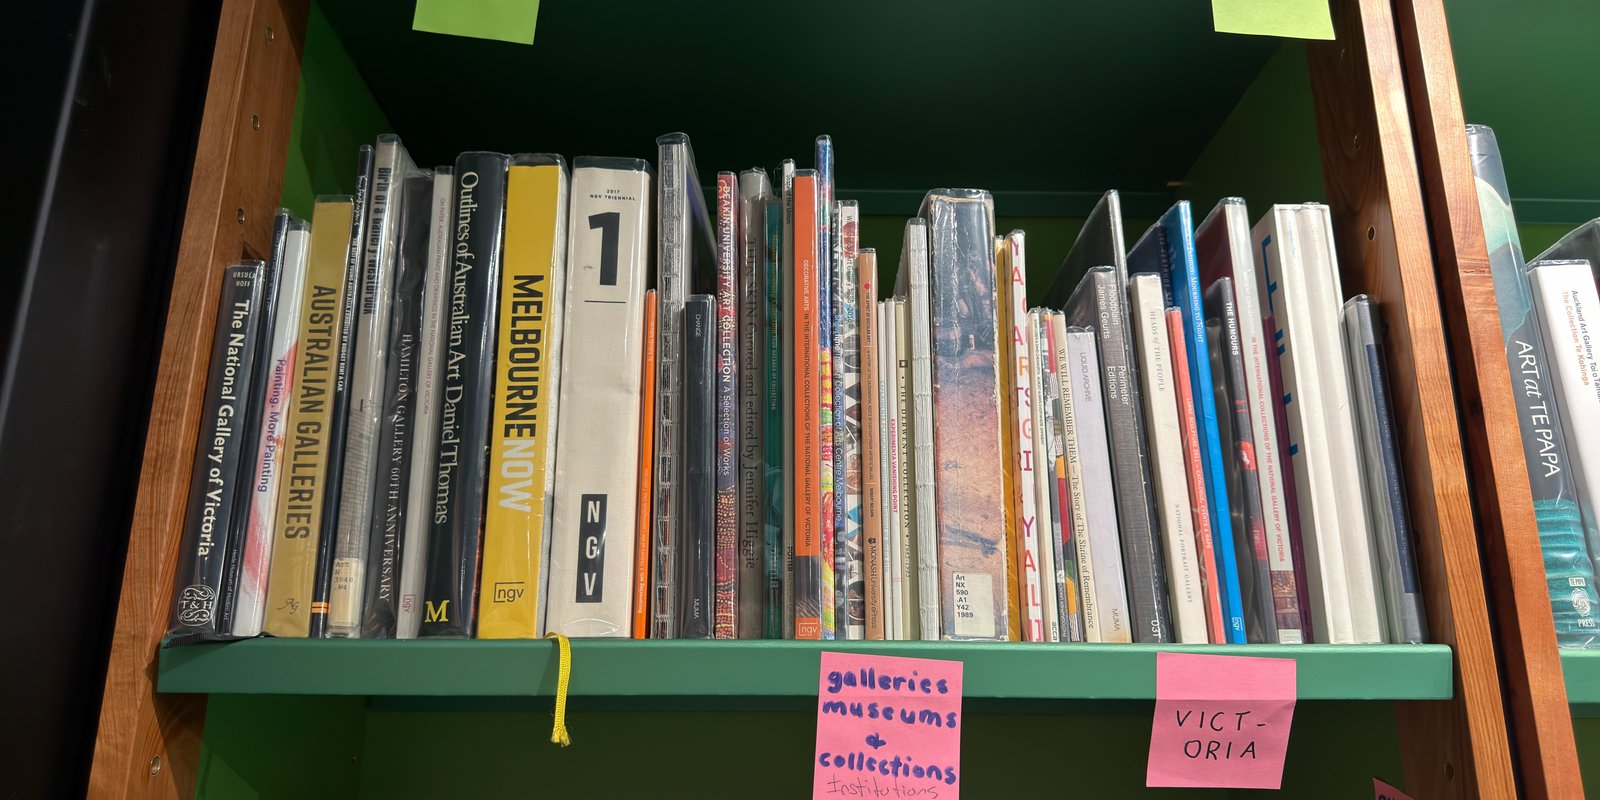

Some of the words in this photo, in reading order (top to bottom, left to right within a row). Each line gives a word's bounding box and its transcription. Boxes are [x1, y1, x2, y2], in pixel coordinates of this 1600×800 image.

[457, 172, 478, 240] Outlines
[723, 187, 731, 223] DEAKIN
[456, 243, 474, 259] of
[588, 212, 620, 285] 1
[723, 228, 731, 287] UNIVERSITY
[449, 262, 472, 347] Australian
[722, 291, 731, 311] ART
[1098, 284, 1106, 309] James
[1108, 284, 1119, 324] Floodplain
[1191, 276, 1200, 311] MOURNING
[1562, 291, 1571, 303] The
[1571, 290, 1585, 322] Auckland
[232, 299, 250, 329] The
[1101, 312, 1110, 339] Geurts
[1149, 312, 1158, 335] HEADS
[1566, 306, 1580, 342] Collection
[1580, 323, 1588, 334] Art
[299, 285, 337, 413] AUSTRALIAN
[723, 315, 731, 382] COLLECTION
[745, 323, 757, 370] Curated
[1228, 319, 1239, 355] HUMOURS
[1582, 335, 1593, 360] Gallery
[221, 334, 245, 400] National
[397, 334, 412, 401] HAMILTON
[447, 350, 466, 381] Art
[1058, 349, 1066, 366] WE
[1080, 353, 1088, 372] LIQUID
[1153, 347, 1161, 362] THE
[1515, 340, 1540, 378] ART
[1590, 362, 1599, 371] Toi
[270, 359, 287, 407] Painting.
[1107, 366, 1117, 398] Editions
[1155, 364, 1164, 392] PEOPLE
[1254, 356, 1263, 400] INTERNATIONAL
[1577, 355, 1590, 385] Kohinga
[746, 374, 756, 397] and
[834, 380, 842, 420] Collection
[1083, 374, 1091, 402] ARCHIVE
[1117, 366, 1129, 406] Perimeter
[1524, 379, 1542, 398] at
[441, 384, 463, 445] Daniel
[723, 395, 731, 434] Selection
[746, 401, 756, 440] edited
[1062, 387, 1073, 435] REMEMBER
[1259, 401, 1268, 441] COLLECTIONS
[1529, 401, 1550, 426] TE
[208, 405, 235, 463] Gallery
[267, 412, 279, 441] More
[393, 406, 406, 464] GALLERY
[723, 437, 731, 446] of
[805, 423, 810, 431] OF
[835, 432, 843, 446] Arts
[743, 446, 756, 461] by
[1067, 437, 1076, 463] THEM
[1263, 443, 1270, 451] OF
[1533, 428, 1560, 477] PAPA
[209, 468, 224, 486] of
[257, 445, 275, 492] Painting
[284, 422, 321, 539] GALLERIES
[1188, 417, 1196, 446] SCULPTURE
[1200, 505, 1208, 526] EVENTS
[388, 468, 400, 500] 60TH
[435, 445, 458, 524] Thomas
[743, 464, 758, 516] Jennifer
[805, 507, 810, 515] OF
[835, 478, 844, 521] Melbourne
[1073, 492, 1081, 511] Story
[1270, 496, 1279, 521] GALLERY
[198, 489, 223, 557] Victoria
[1077, 522, 1085, 537] The
[1274, 523, 1281, 532] OF
[379, 504, 397, 602] ANNIVERSARY
[744, 522, 758, 568] Higgie
[1079, 540, 1088, 563] Shrine
[1175, 504, 1183, 536] NATIONAL
[1180, 540, 1188, 571] PORTRAIT
[1184, 575, 1192, 603] GALLERY
[1276, 534, 1284, 562] VICTORIA
[1082, 565, 1089, 573] of
[498, 589, 523, 603] ngv
[870, 577, 878, 605] University
[1083, 576, 1094, 628] Remembrance
[424, 600, 449, 622] M
[1112, 608, 1120, 631] MUMA
[1232, 619, 1241, 631] ngv
[801, 627, 817, 635] ngv
[828, 667, 948, 694] galleries
[822, 700, 957, 728] museums
[1184, 740, 1256, 760] ORIA
[819, 752, 957, 784] collections
[827, 773, 938, 799] Institutions
